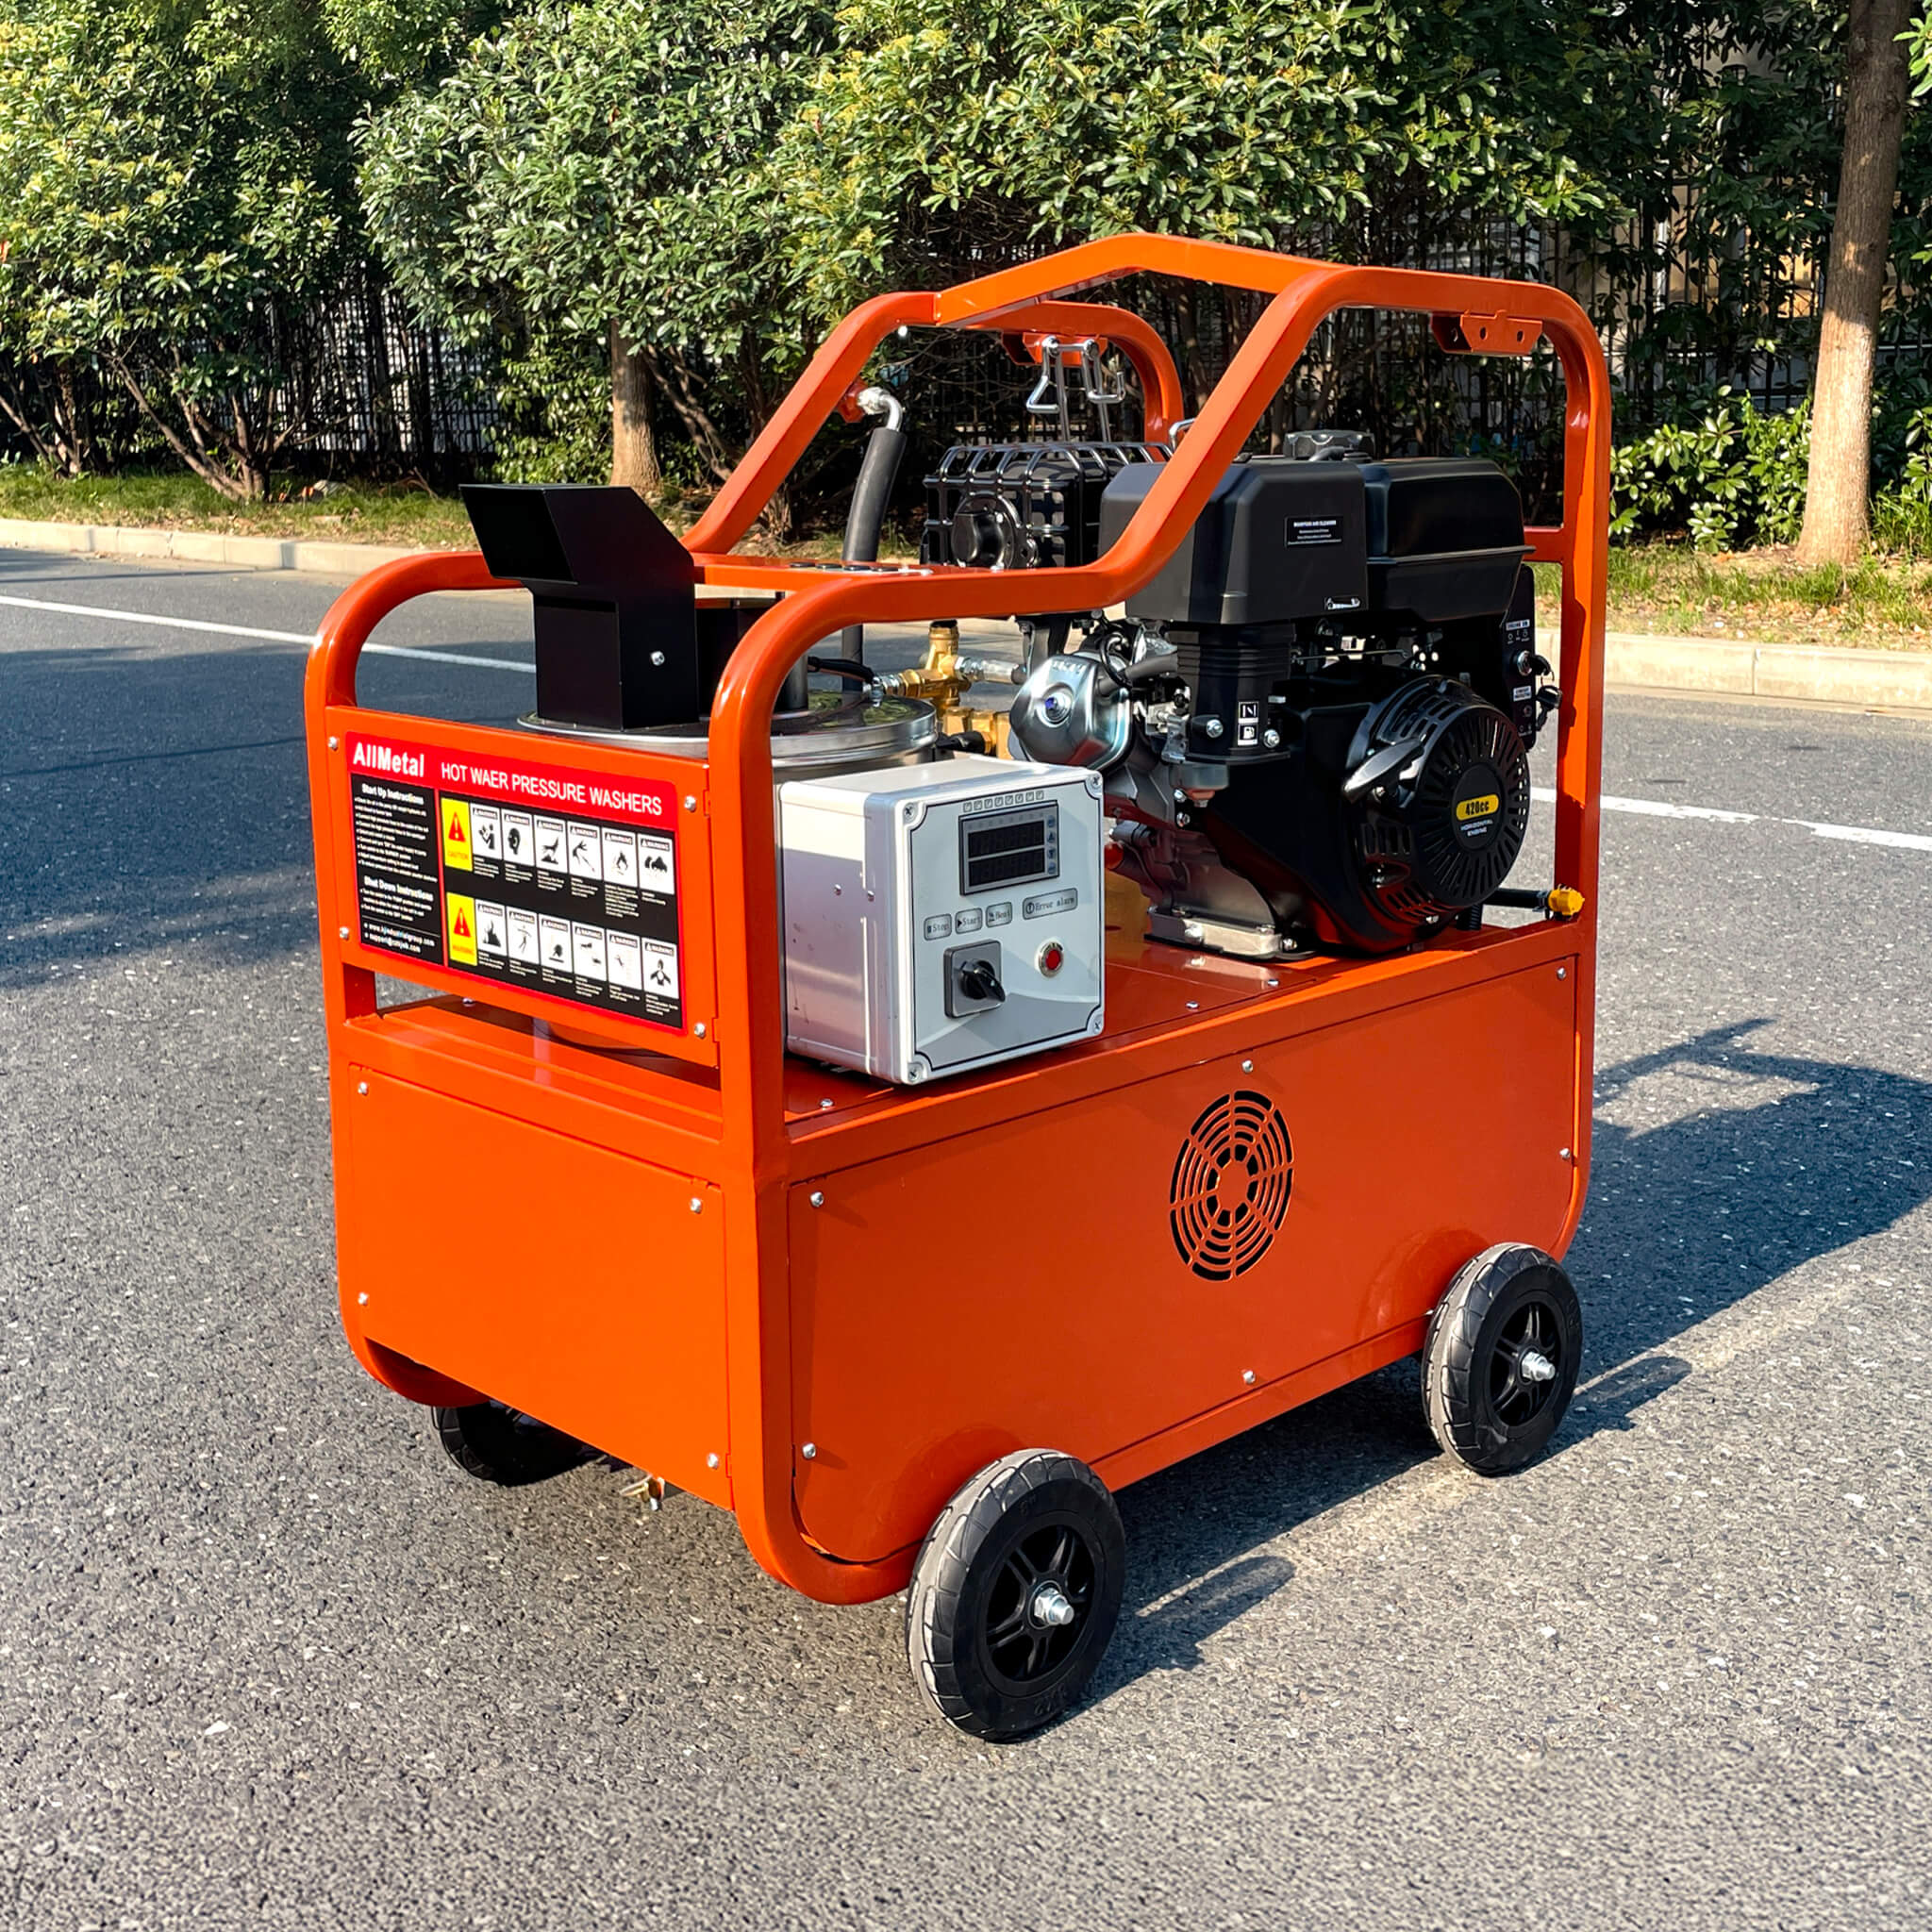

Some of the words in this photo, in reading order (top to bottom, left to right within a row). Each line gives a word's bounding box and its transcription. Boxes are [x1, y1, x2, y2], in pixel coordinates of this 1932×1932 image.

[353, 742, 425, 777] AllMetal
[441, 762, 468, 782] HOT
[470, 766, 509, 791] WAER
[511, 774, 587, 804] PRESSURE
[589, 786, 663, 816] WASHERS
[1465, 801, 1490, 815] 420cc
